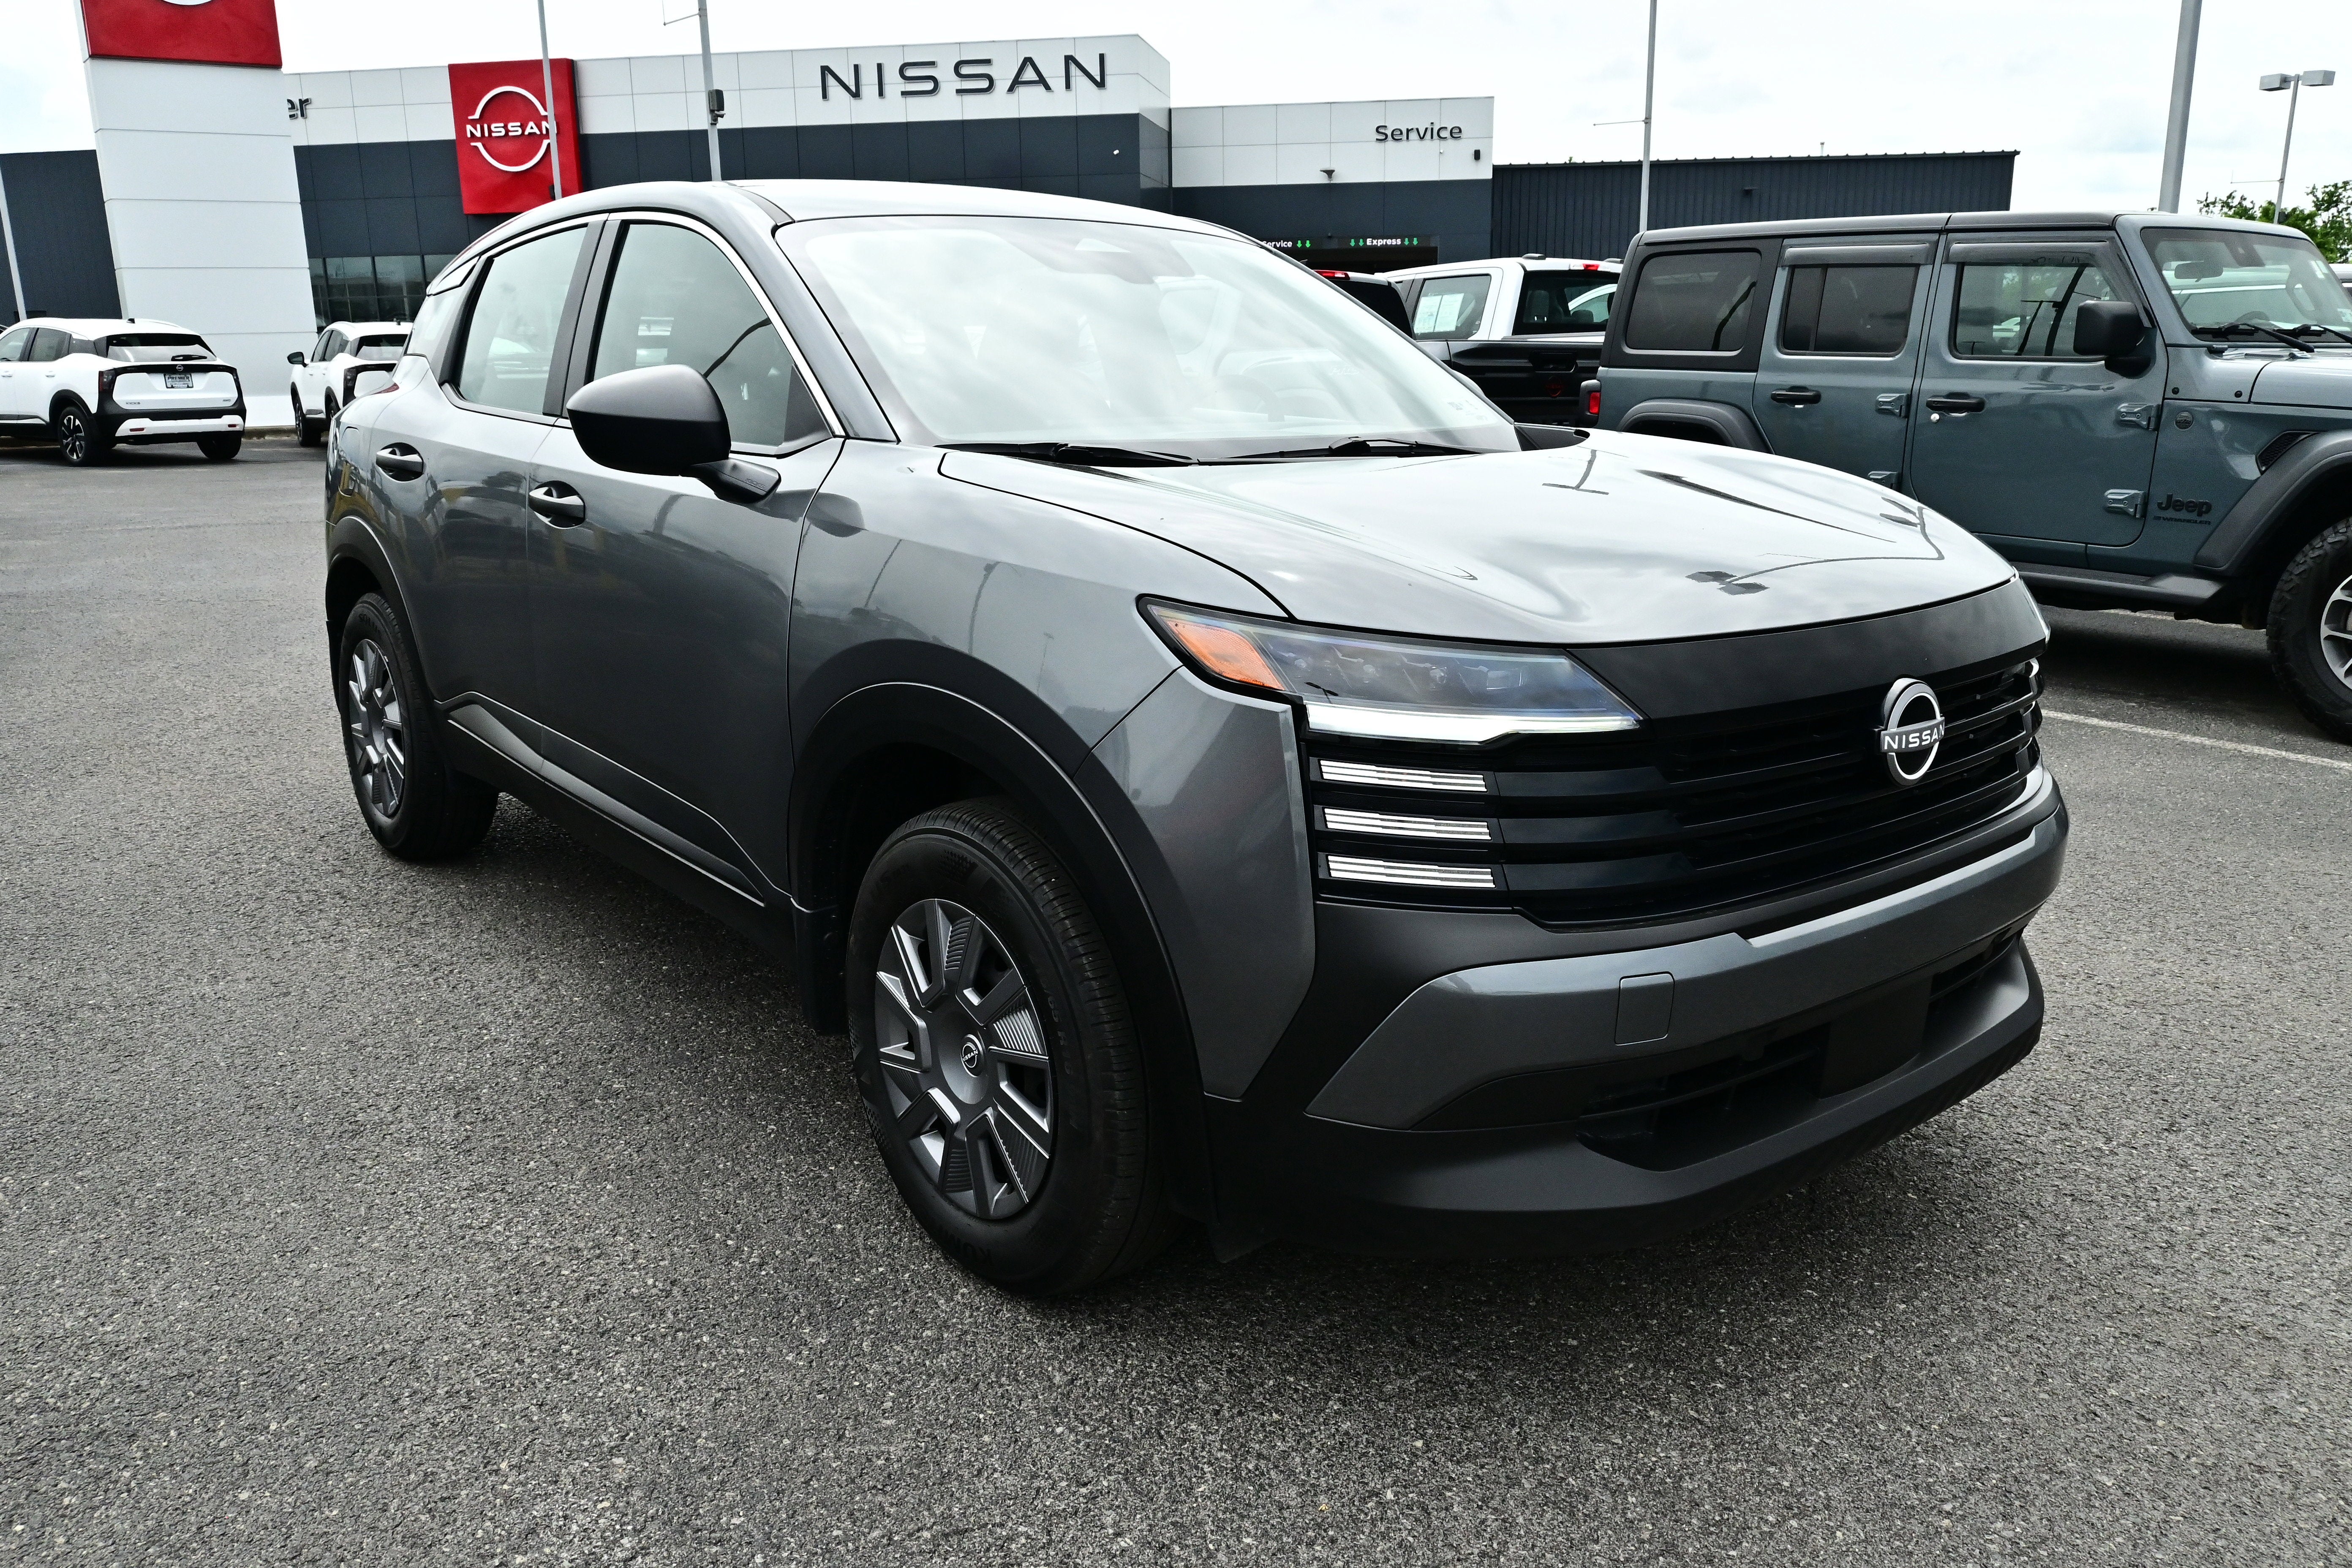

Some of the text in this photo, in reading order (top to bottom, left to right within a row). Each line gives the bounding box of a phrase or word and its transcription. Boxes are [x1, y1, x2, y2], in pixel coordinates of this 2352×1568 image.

[820, 52, 1107, 101] NISSAN
[466, 121, 557, 137] NISSAN
[1375, 122, 1462, 142] Service
[1367, 238, 1402, 246] Express
[2157, 493, 2212, 517] Jeep
[1884, 721, 1945, 750] NISSAN
